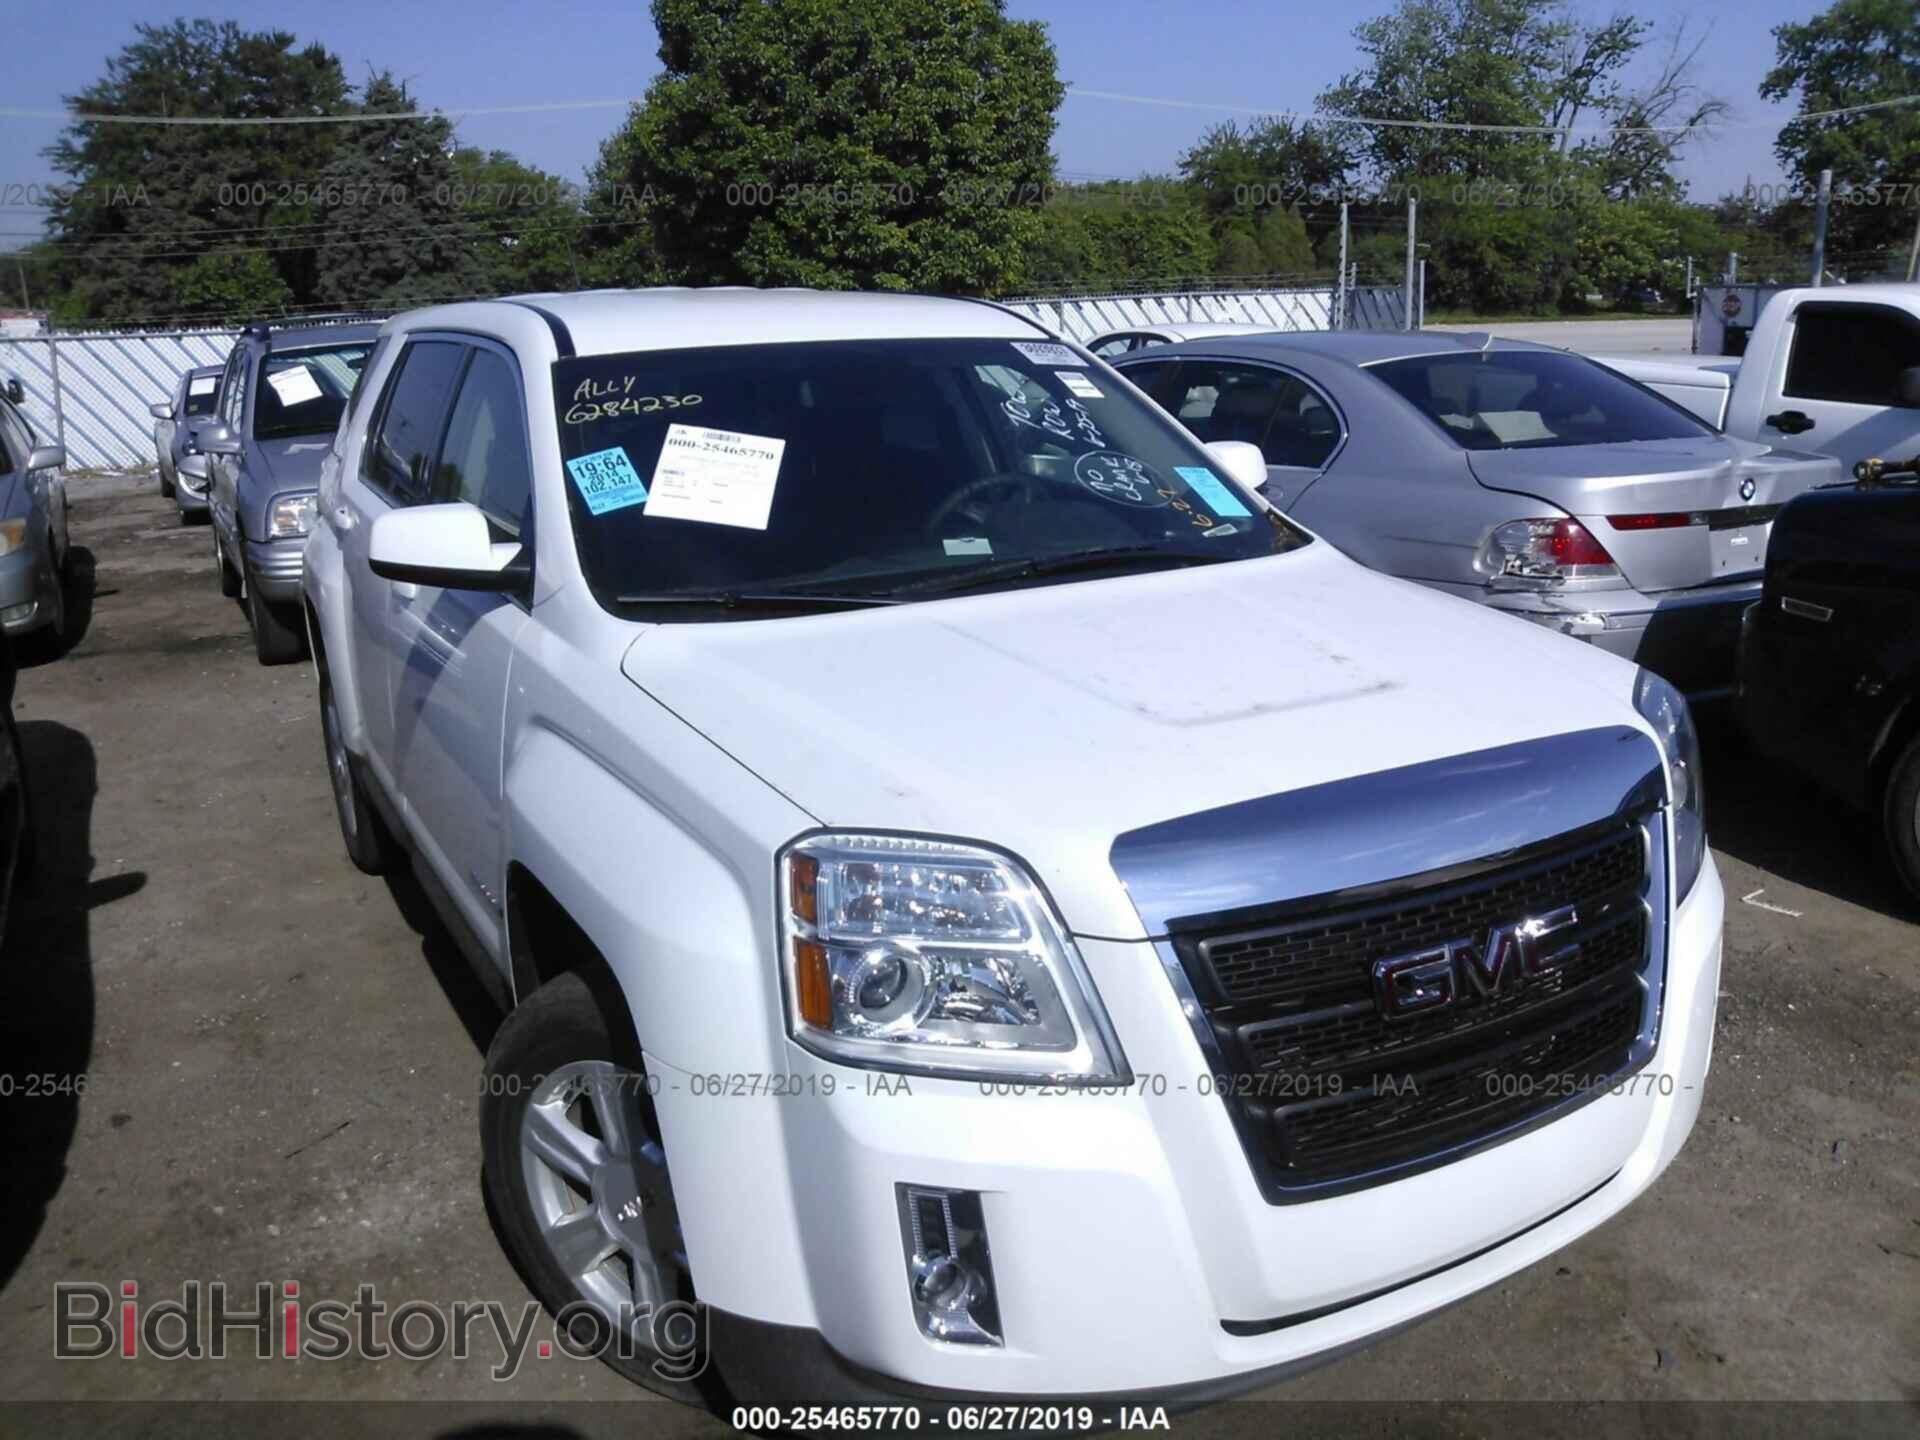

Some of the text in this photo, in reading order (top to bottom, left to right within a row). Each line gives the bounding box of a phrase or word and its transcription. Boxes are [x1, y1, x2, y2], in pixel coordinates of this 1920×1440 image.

[573, 376, 636, 400] ALLY
[565, 394, 703, 424] 6284230
[574, 454, 627, 479] 19:64
[1371, 904, 1581, 1021] GMC
